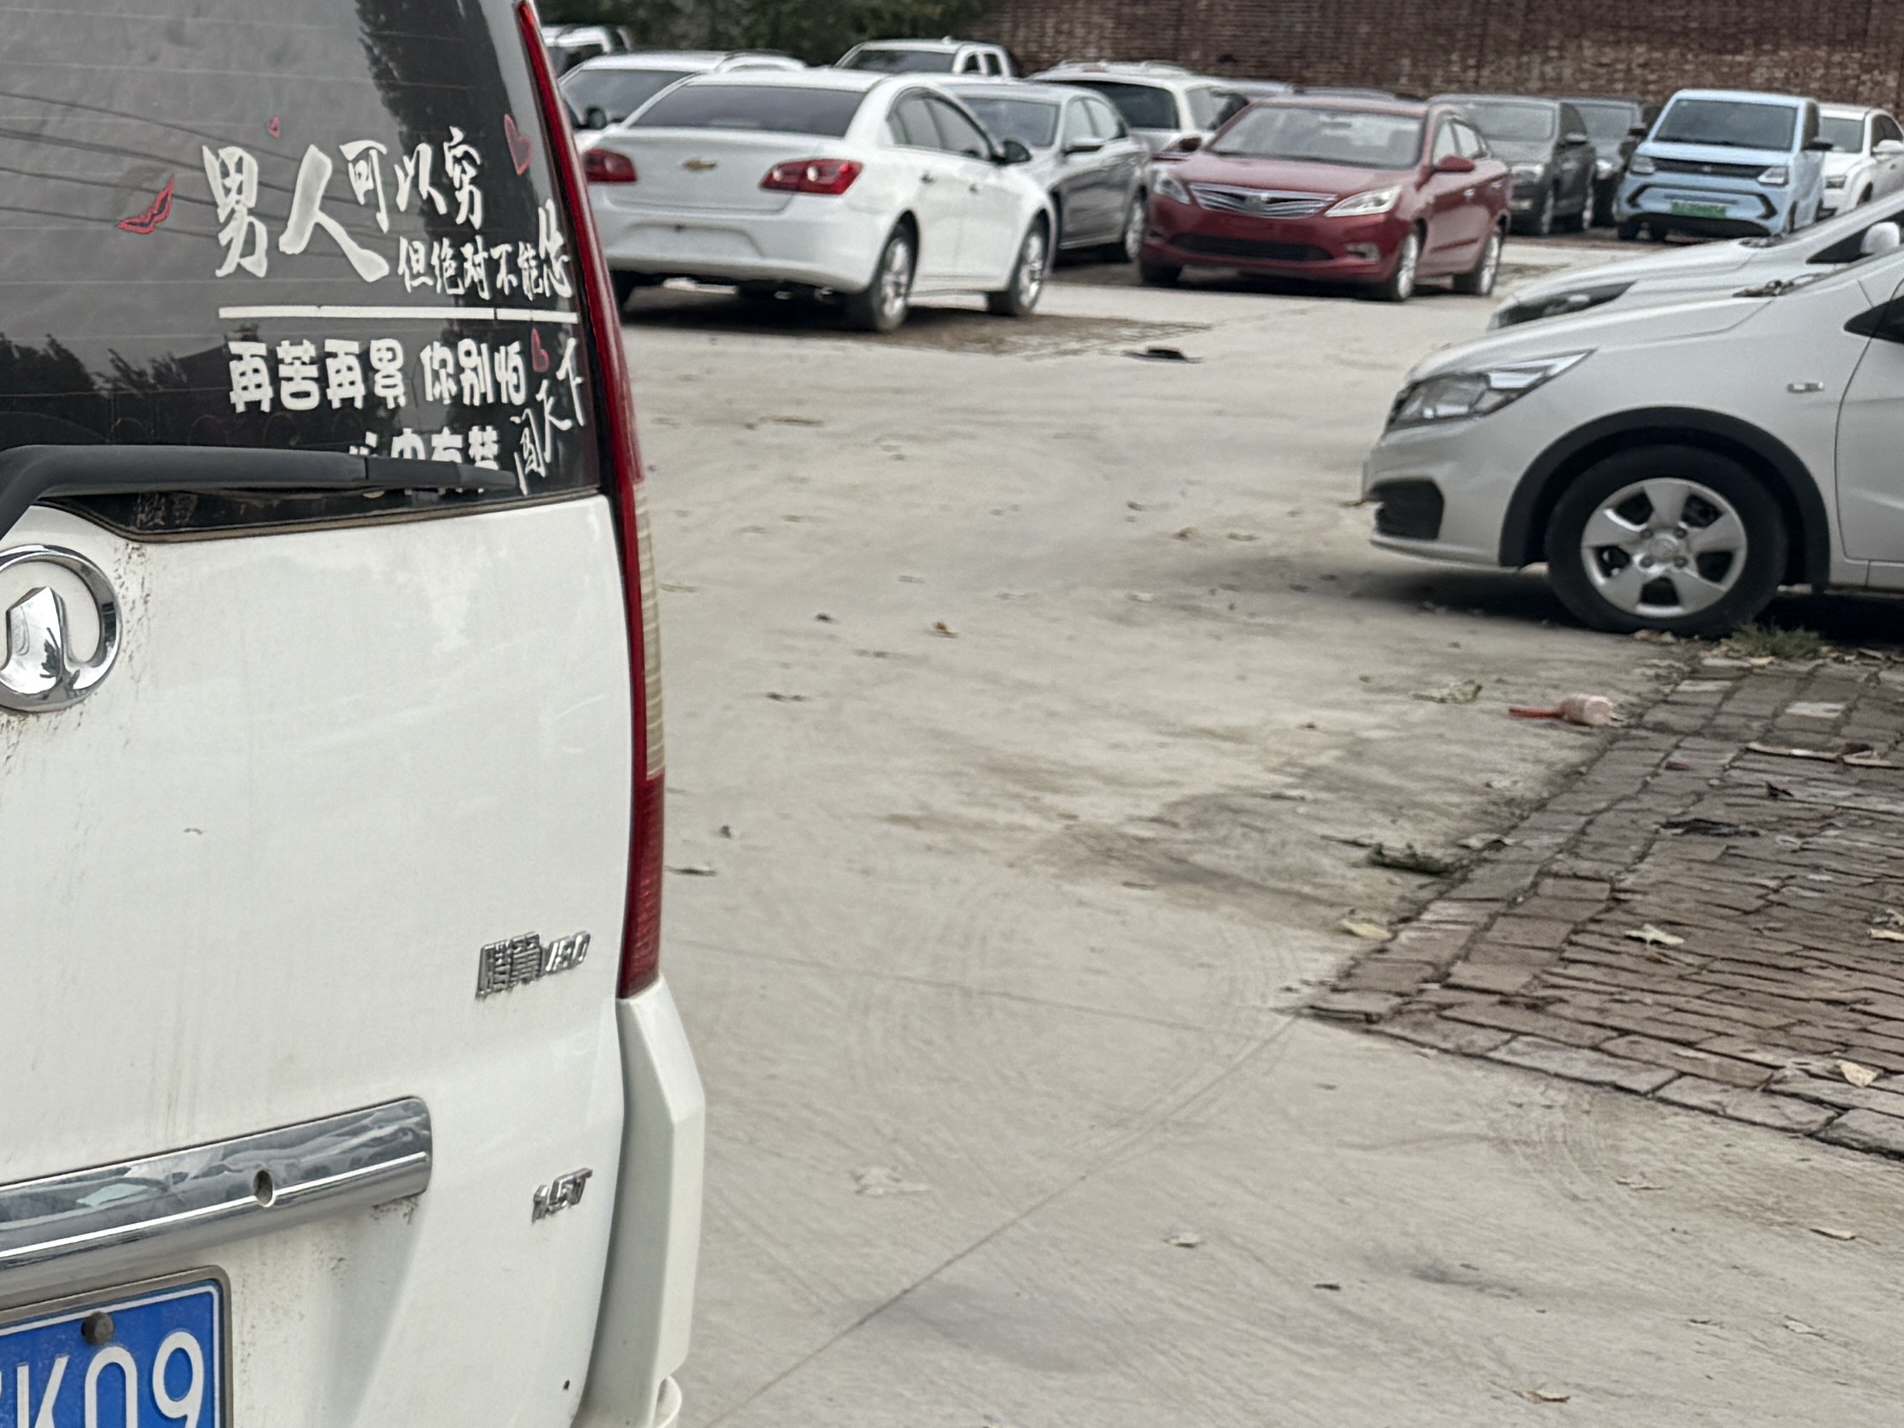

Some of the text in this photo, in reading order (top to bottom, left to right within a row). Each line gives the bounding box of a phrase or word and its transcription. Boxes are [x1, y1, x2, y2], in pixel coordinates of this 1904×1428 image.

[202, 127, 483, 283] 男人可以穷
[228, 337, 527, 413] 再苦再累 你别怕
